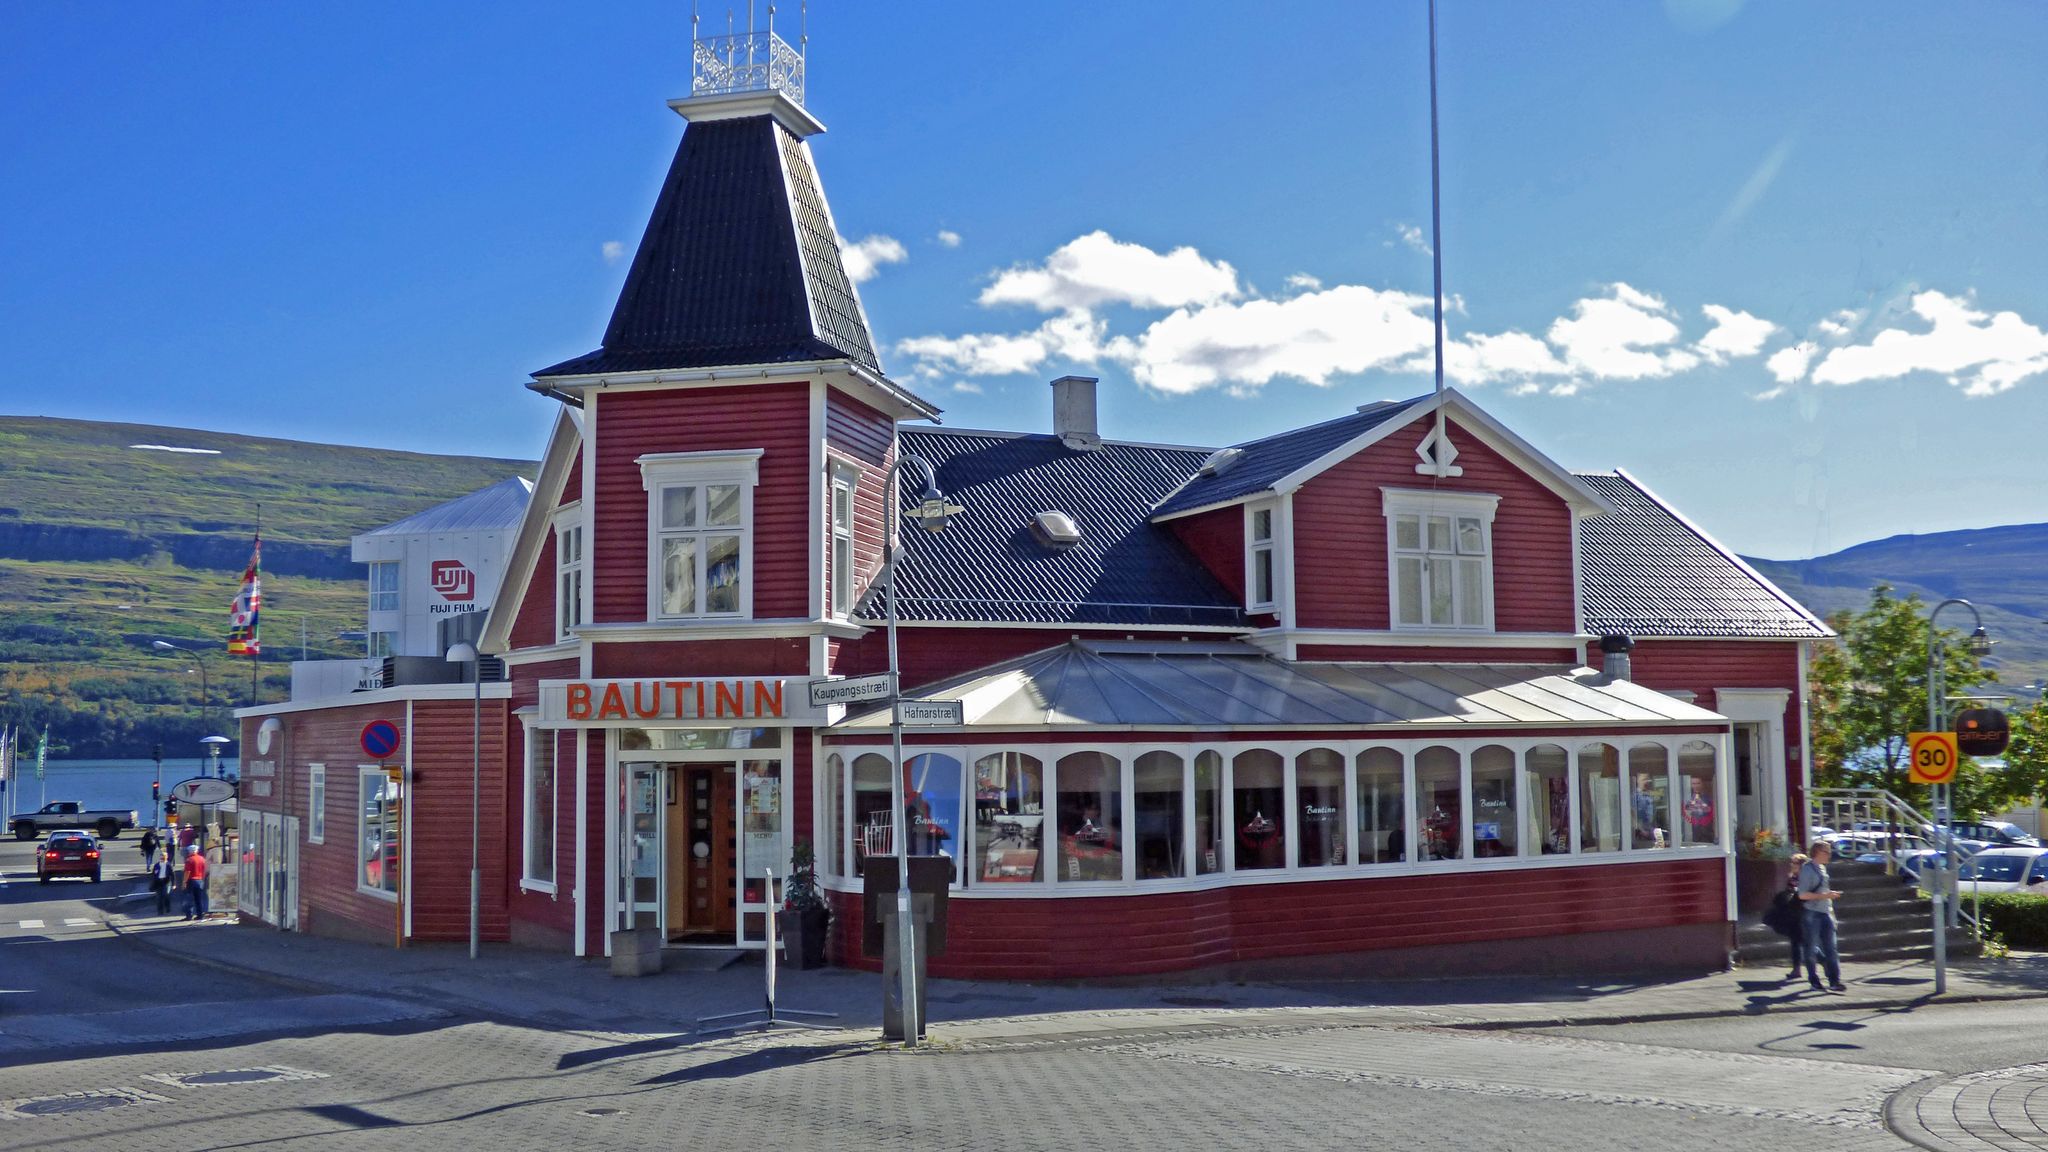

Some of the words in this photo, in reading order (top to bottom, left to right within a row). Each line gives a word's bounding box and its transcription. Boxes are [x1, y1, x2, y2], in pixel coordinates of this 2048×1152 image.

[432, 560, 468, 592] FUJI
[430, 604, 451, 613] FUJI
[453, 603, 475, 613] FILM
[813, 680, 889, 700] Kaupvangsstræti
[567, 680, 783, 720] BAUTINN
[904, 706, 958, 719] Hafnarstræti
[1919, 749, 1946, 766] 30
[1305, 805, 1336, 815] Bautinn
[912, 815, 949, 825] Bautinn
